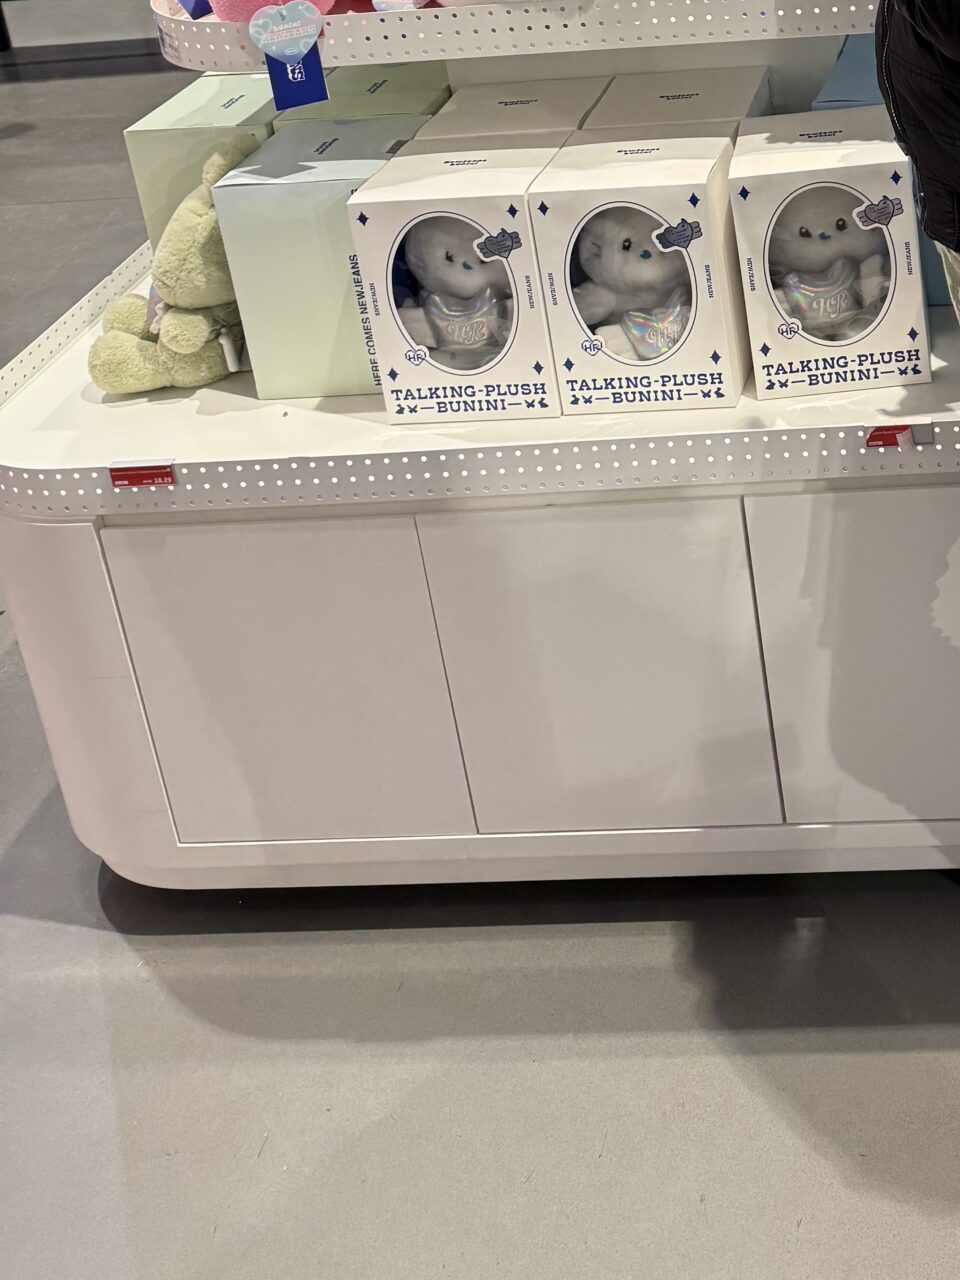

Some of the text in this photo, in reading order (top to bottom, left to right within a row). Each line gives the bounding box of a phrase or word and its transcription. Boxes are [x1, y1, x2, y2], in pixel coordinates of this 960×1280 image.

[349, 254, 369, 316] NEWJEANS
[360, 316, 376, 357] COMES
[762, 349, 921, 377] TALKING-PLUSH
[566, 372, 724, 391] TALKING-PLUSH
[808, 368, 880, 386] BUNINI
[391, 383, 547, 401] TALKING-PLUSH
[612, 389, 683, 404] BUNINI
[437, 399, 507, 413] BUNINI
